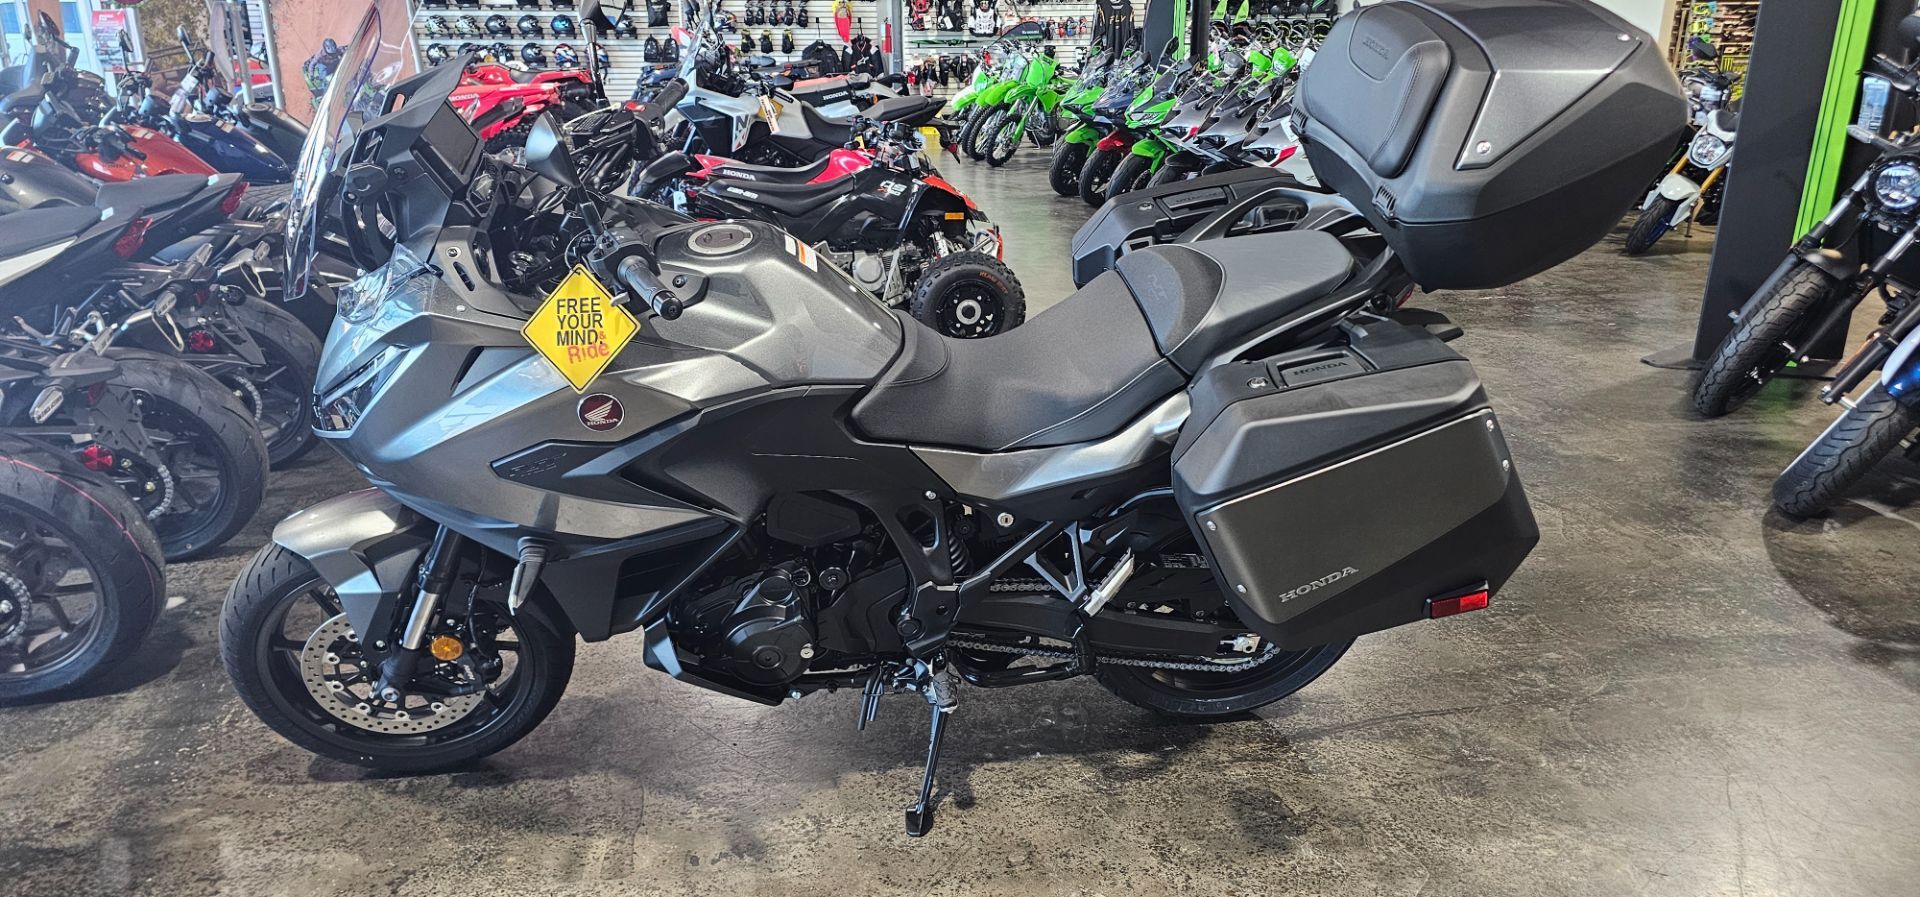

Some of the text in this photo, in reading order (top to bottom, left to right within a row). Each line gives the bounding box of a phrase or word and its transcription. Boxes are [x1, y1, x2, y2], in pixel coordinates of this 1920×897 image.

[448, 93, 480, 102] HONDA
[822, 90, 849, 101] HONDA
[722, 168, 757, 181] HONDA
[556, 297, 601, 314] FREE
[556, 313, 603, 329] YOUR
[567, 343, 610, 364] Ride
[1293, 361, 1349, 376] HONDA
[586, 417, 619, 426] HONDA
[1279, 566, 1360, 603] HONDA
